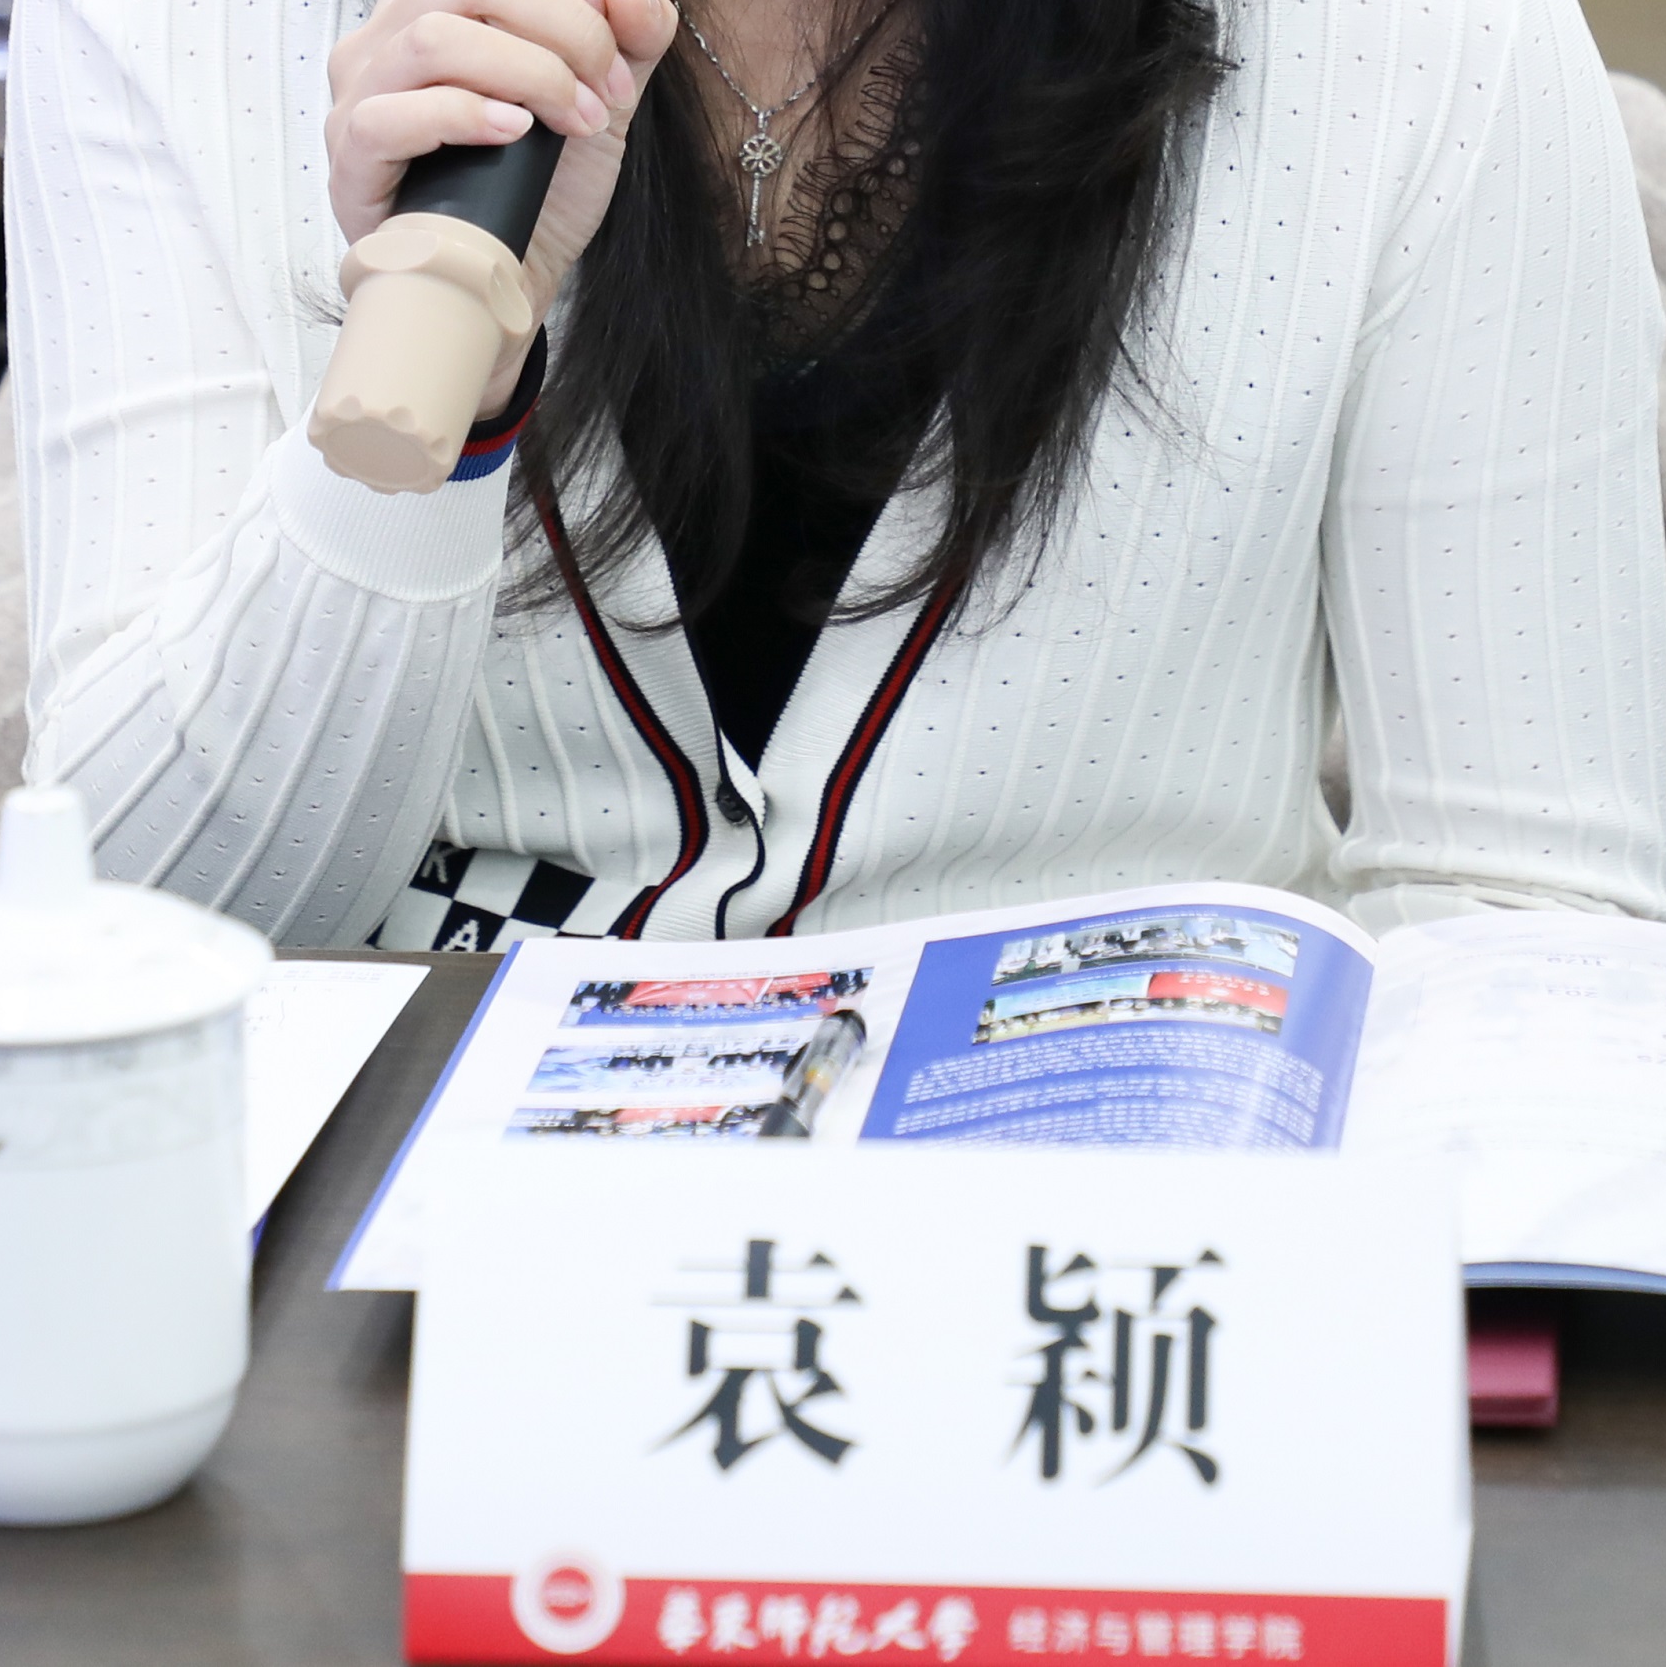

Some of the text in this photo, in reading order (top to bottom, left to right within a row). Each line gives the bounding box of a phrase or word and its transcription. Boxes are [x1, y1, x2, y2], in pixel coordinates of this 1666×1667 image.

[442, 920, 480, 952] A
[1008, 1604, 1304, 1661] 经济与管理学院
